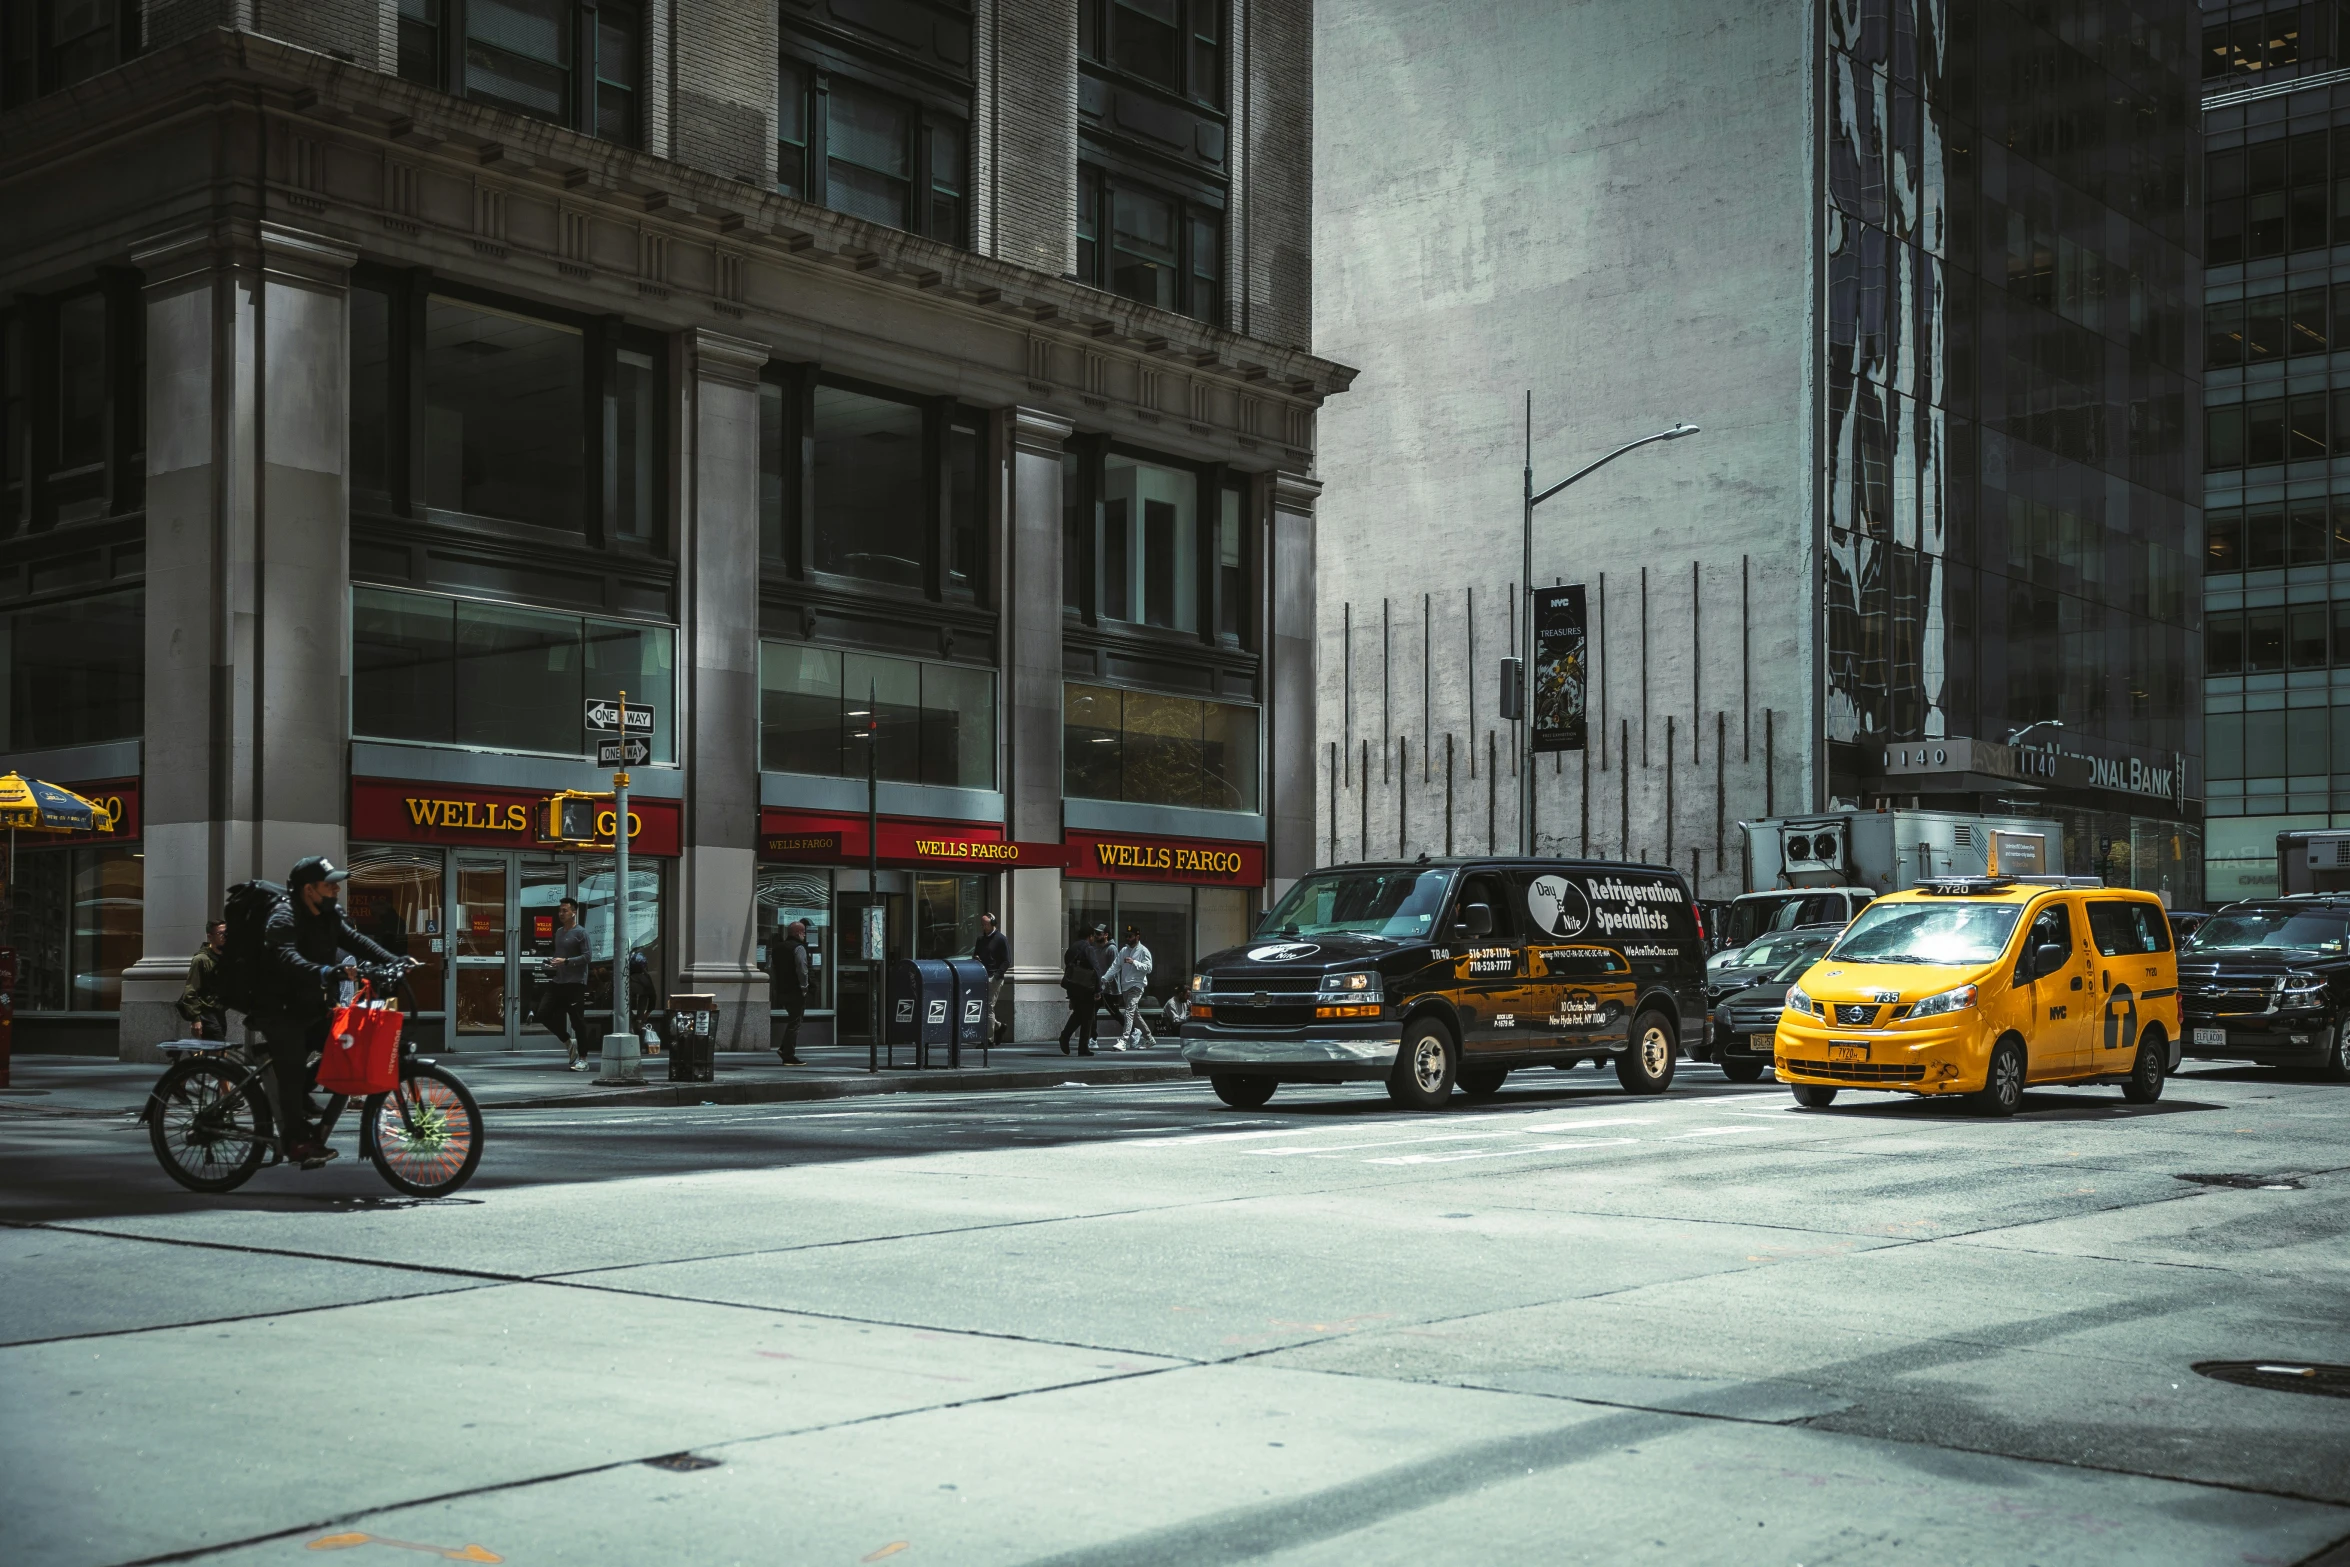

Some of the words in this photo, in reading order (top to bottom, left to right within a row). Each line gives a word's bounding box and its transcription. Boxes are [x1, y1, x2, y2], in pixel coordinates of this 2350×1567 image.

[1550, 598, 1569, 608] NYC
[1540, 626, 1582, 638] TREASURES
[595, 710, 616, 722] ONE
[626, 712, 648, 724] WAY
[605, 748, 620, 760] ONE
[626, 746, 643, 758] WAY
[1884, 749, 1946, 766] 1140
[2022, 751, 2056, 778] 1140
[2130, 758, 2172, 796] BANK
[405, 798, 527, 831] WELLS
[769, 840, 801, 850] WELLS
[802, 838, 833, 849] FARGO
[916, 840, 968, 857] WELLS
[971, 843, 1018, 860] FARGO
[1097, 843, 1170, 869] WELLS
[1175, 849, 1242, 872] FARGO
[1536, 882, 1556, 898] Day
[1586, 877, 1683, 907] Refrigeration
[1937, 885, 1969, 894] 7Y20
[1557, 899, 1565, 913] &
[1563, 914, 1581, 930] Nite
[1595, 906, 1669, 935] Specialists
[1431, 949, 1449, 960] TR40
[1469, 948, 1511, 958] 516-378-1176
[1624, 945, 1678, 956] WeAreTheOne.com
[1470, 960, 1511, 972] 718-528-7777
[2145, 968, 2157, 977] 7Y20
[1876, 992, 1898, 1002] 735
[2050, 1006, 2067, 1020] NYC
[388, 1030, 402, 1075] DOORDASH
